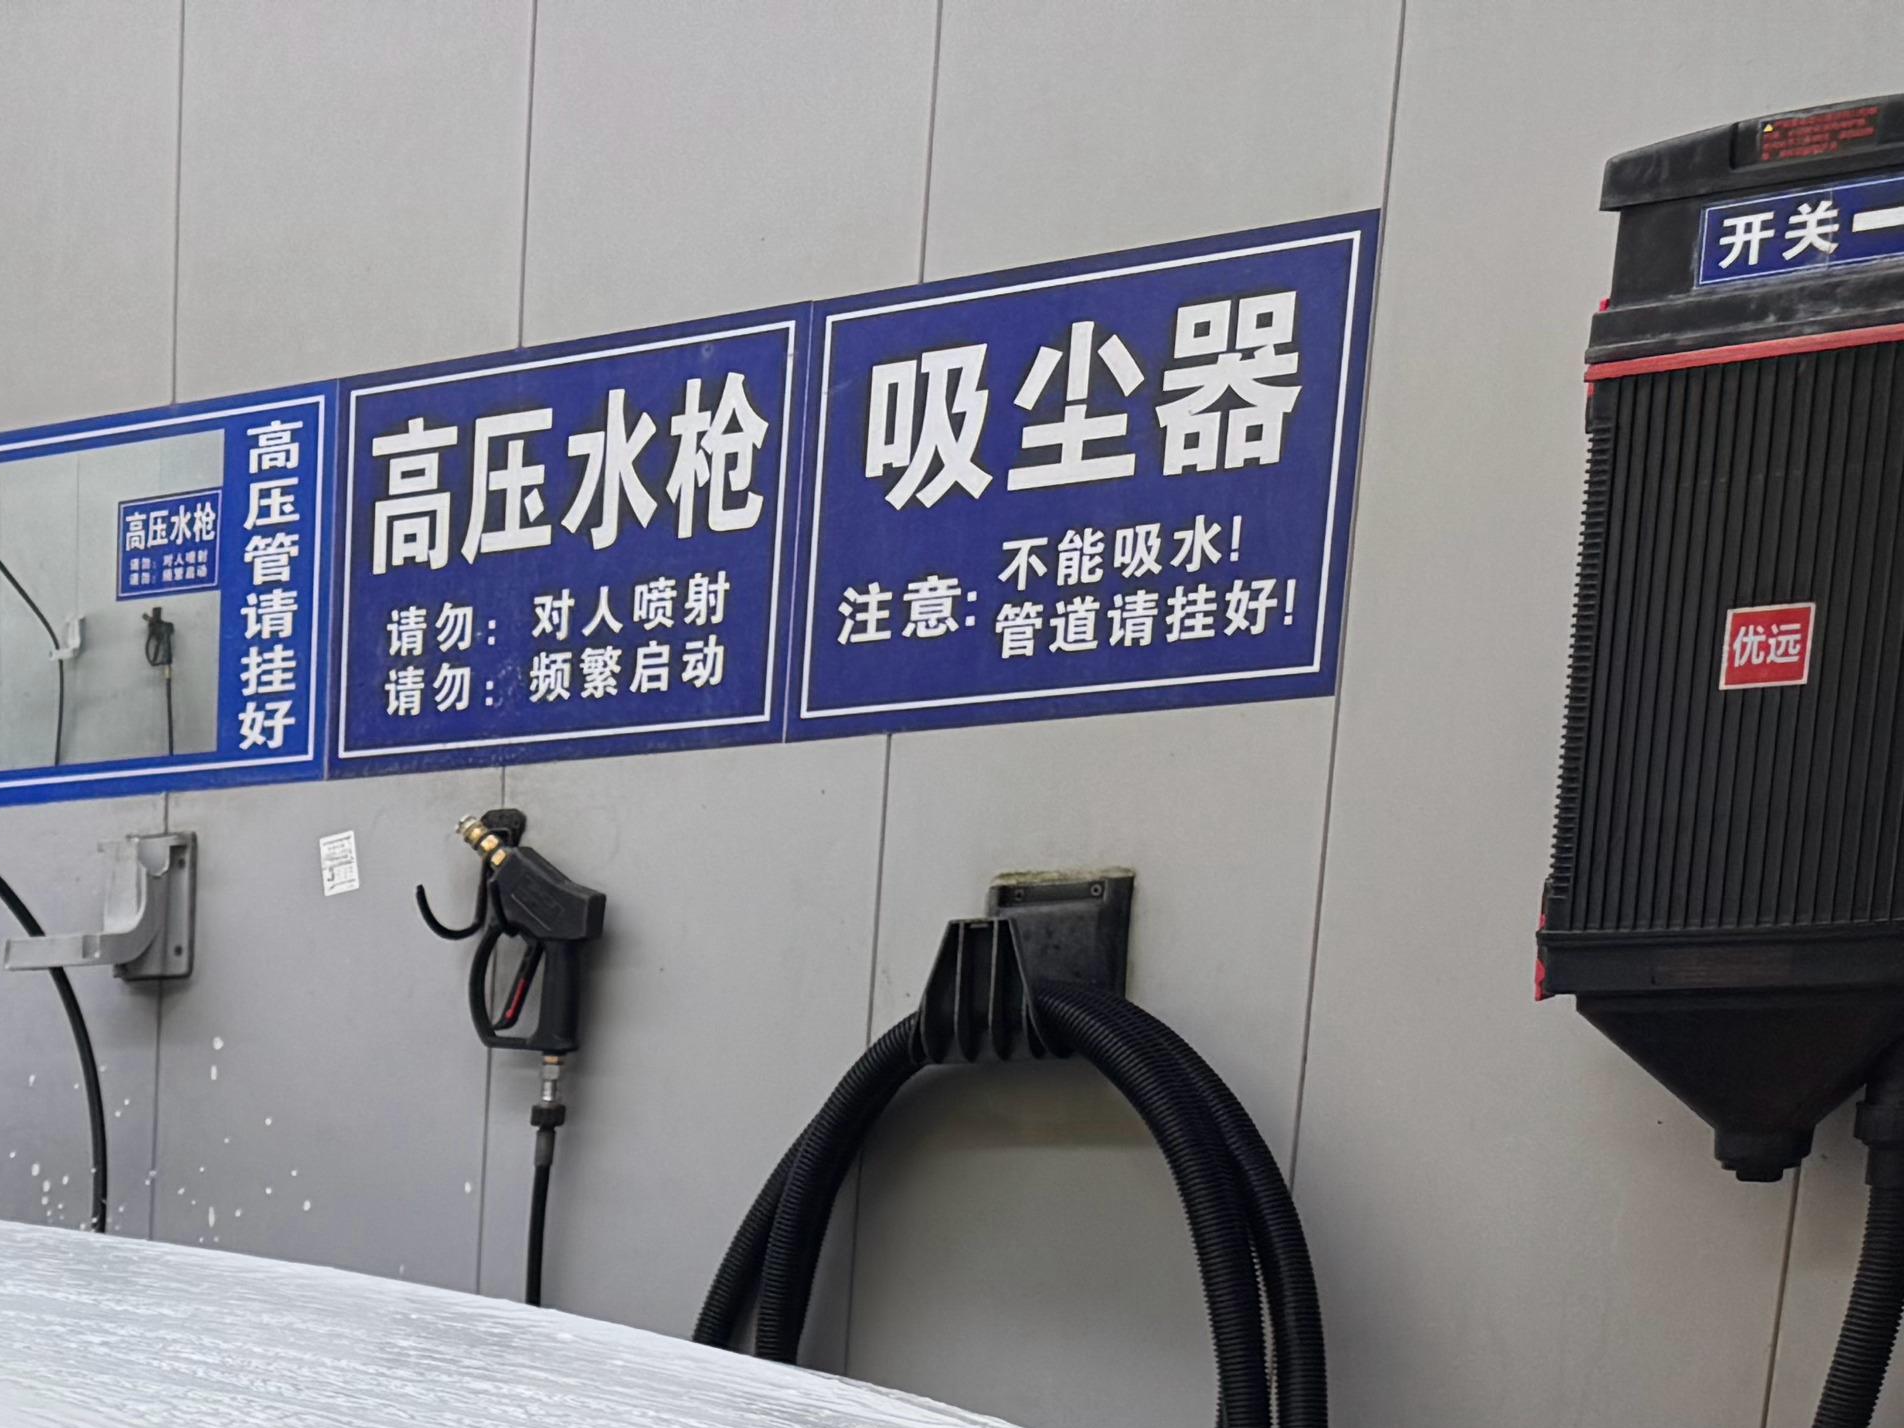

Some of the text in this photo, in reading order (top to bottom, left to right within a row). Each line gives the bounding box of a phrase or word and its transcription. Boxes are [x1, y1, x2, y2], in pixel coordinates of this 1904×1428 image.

[865, 290, 1303, 511] 吸尘器
[372, 372, 769, 575] 高压水枪
[125, 501, 216, 552] 高压水枪
[998, 514, 1243, 591] 不能吸水！
[238, 420, 304, 751] 高压管请挂好
[386, 570, 731, 657] 请勿： 对人喷射
[837, 575, 978, 645] 注意：
[994, 578, 1297, 659] 管道请挂好！
[384, 634, 725, 717] 请勿： 频繁启动
[1733, 623, 1801, 668] 优远
